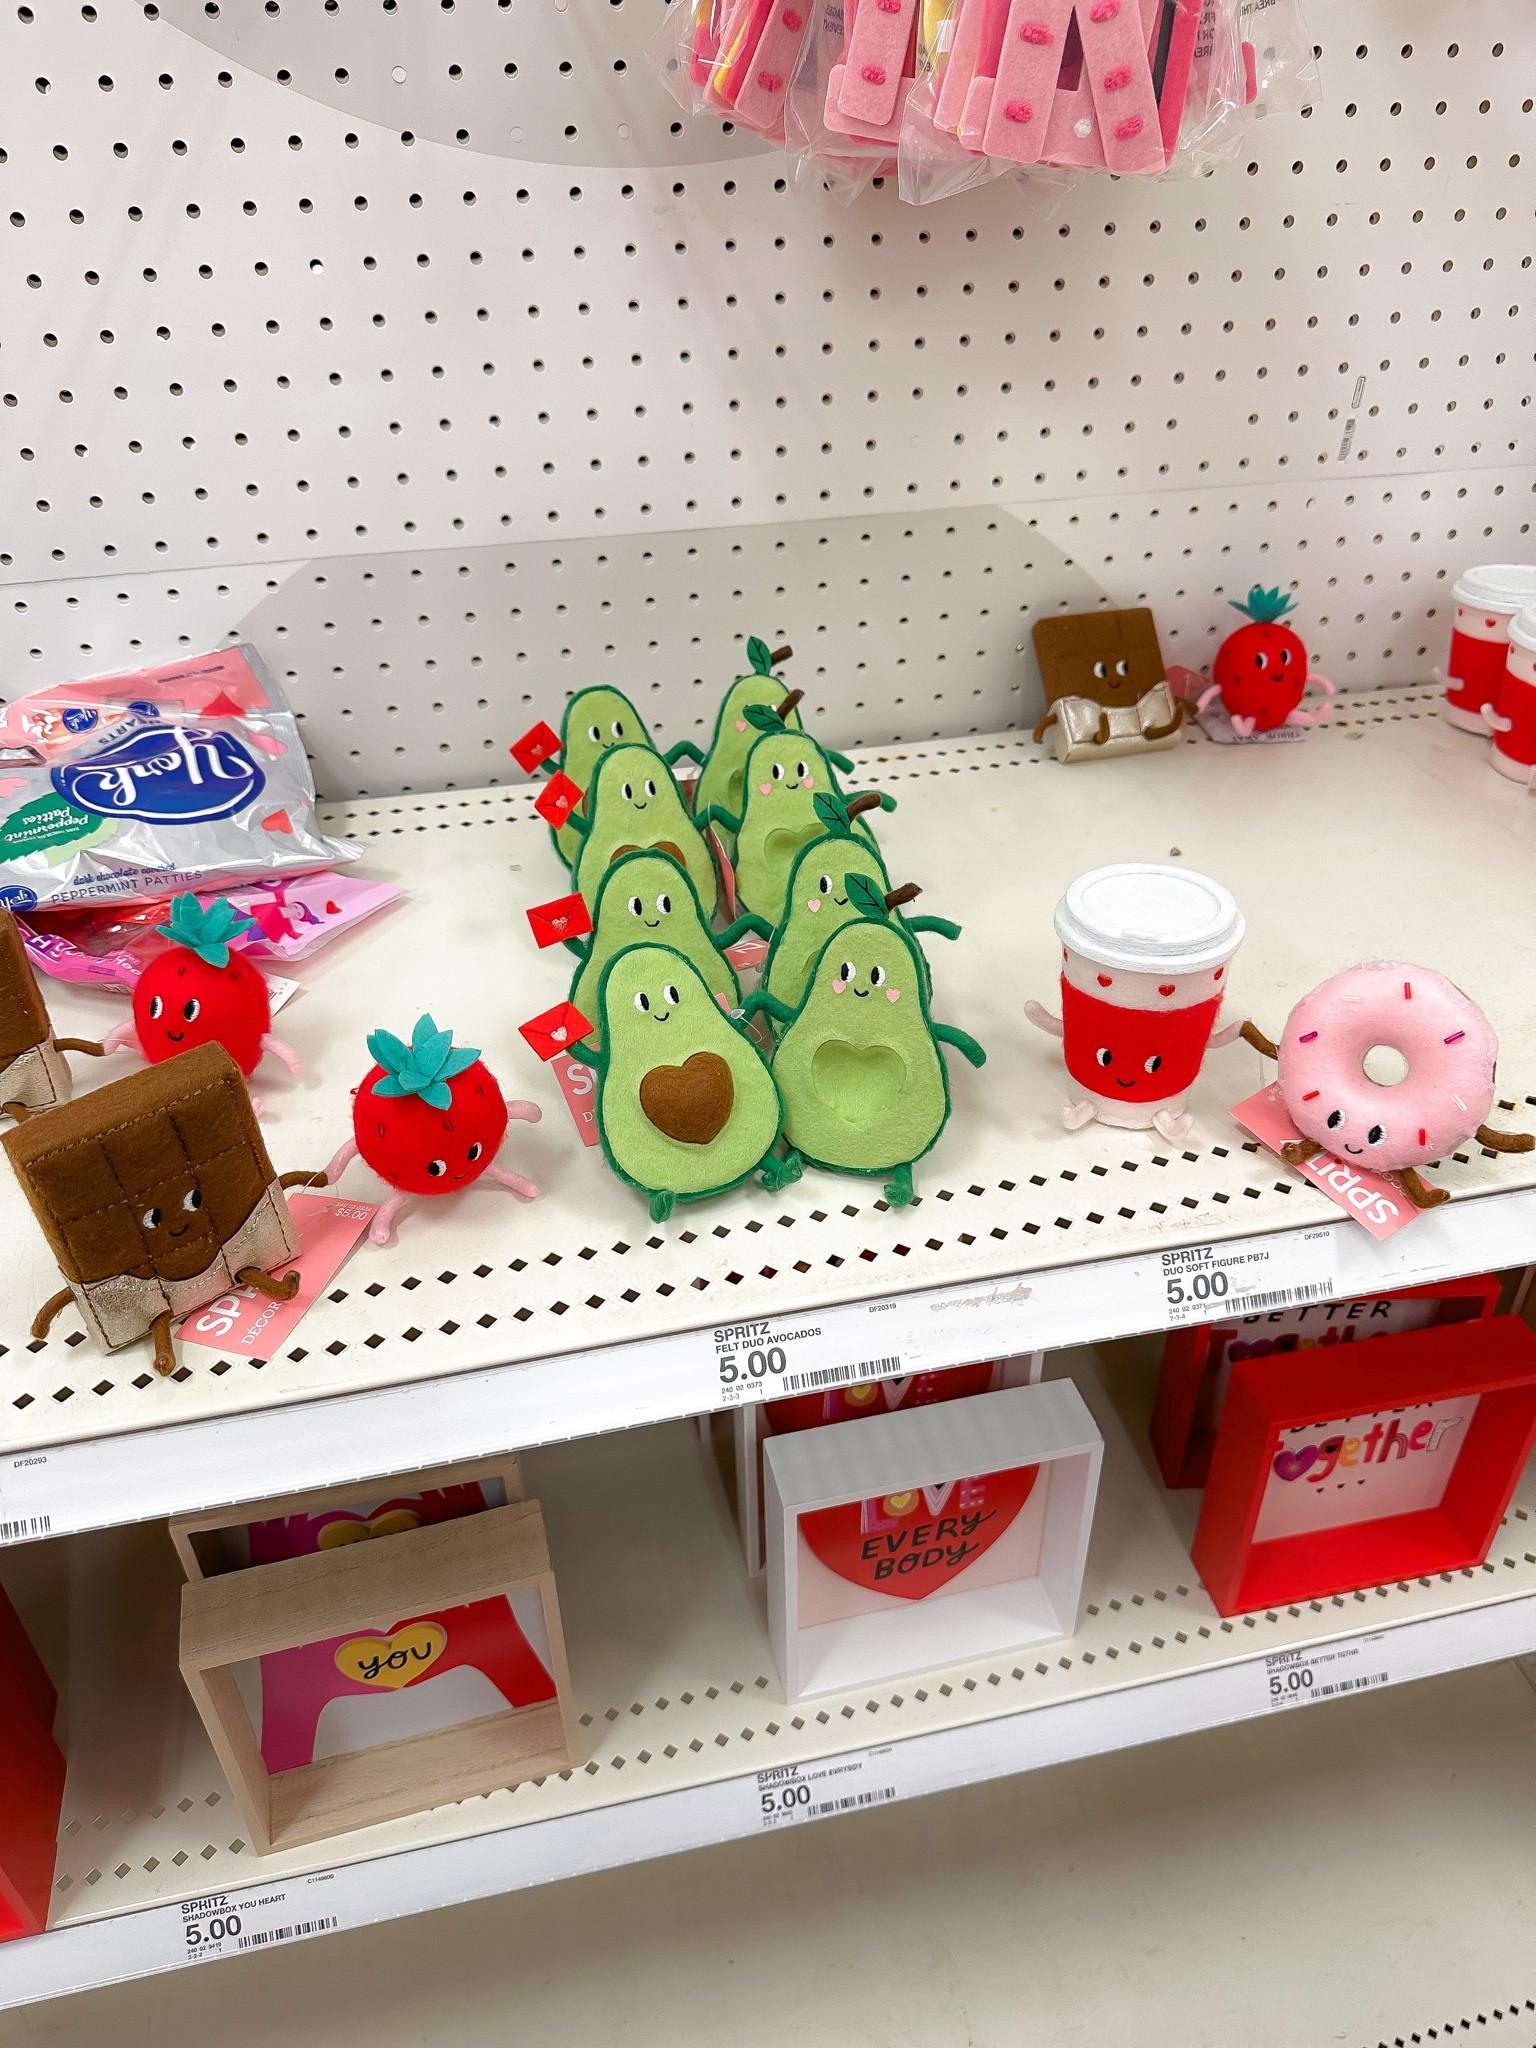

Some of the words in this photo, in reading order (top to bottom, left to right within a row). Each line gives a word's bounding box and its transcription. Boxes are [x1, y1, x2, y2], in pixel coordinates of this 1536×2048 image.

[85, 728, 254, 808] York
[3, 815, 89, 842] Peppermint
[22, 807, 70, 825] Patties
[51, 880, 139, 905] PEPPERMINT
[145, 870, 203, 886] PATTIES
[73, 874, 94, 886] dark
[96, 868, 139, 881] chocolate
[335, 1207, 368, 1221] $5.00
[1161, 1247, 1214, 1266] SPRITZ
[1163, 1265, 1184, 1277] DUO
[1186, 1262, 1210, 1273] SOFT
[1212, 1257, 1245, 1269] FIGURE
[1247, 1251, 1270, 1263] PB7J
[1167, 1271, 1229, 1304] 5.00
[869, 1303, 896, 1313] DF20319
[240, 1301, 283, 1345] DÉCOR
[714, 1321, 770, 1343] SPRITZ
[715, 1342, 740, 1354] FELT
[742, 1338, 765, 1350] DUO
[767, 1327, 822, 1345] AVOCADOS
[720, 1347, 787, 1383] 5.00
[721, 1386, 734, 1394] 240
[735, 1384, 744, 1392] 02
[746, 1381, 763, 1390] 0373
[861, 1508, 996, 1561] EVERY
[873, 1542, 979, 1581] BODY
[1265, 1651, 1303, 1667] SPRITZ
[1270, 1668, 1313, 1695] 5.00
[757, 1766, 799, 1783] SPRITZ
[758, 1774, 807, 1791] SHADOWBOX
[808, 1770, 827, 1781] LOVE
[761, 1784, 811, 1813] 5.00
[181, 1894, 229, 1914] SPRITZ
[182, 1905, 237, 1923] SHADOWBOX
[238, 1900, 257, 1911] YOU
[258, 1893, 286, 1906] HEART
[185, 1915, 242, 1946] 5.00
